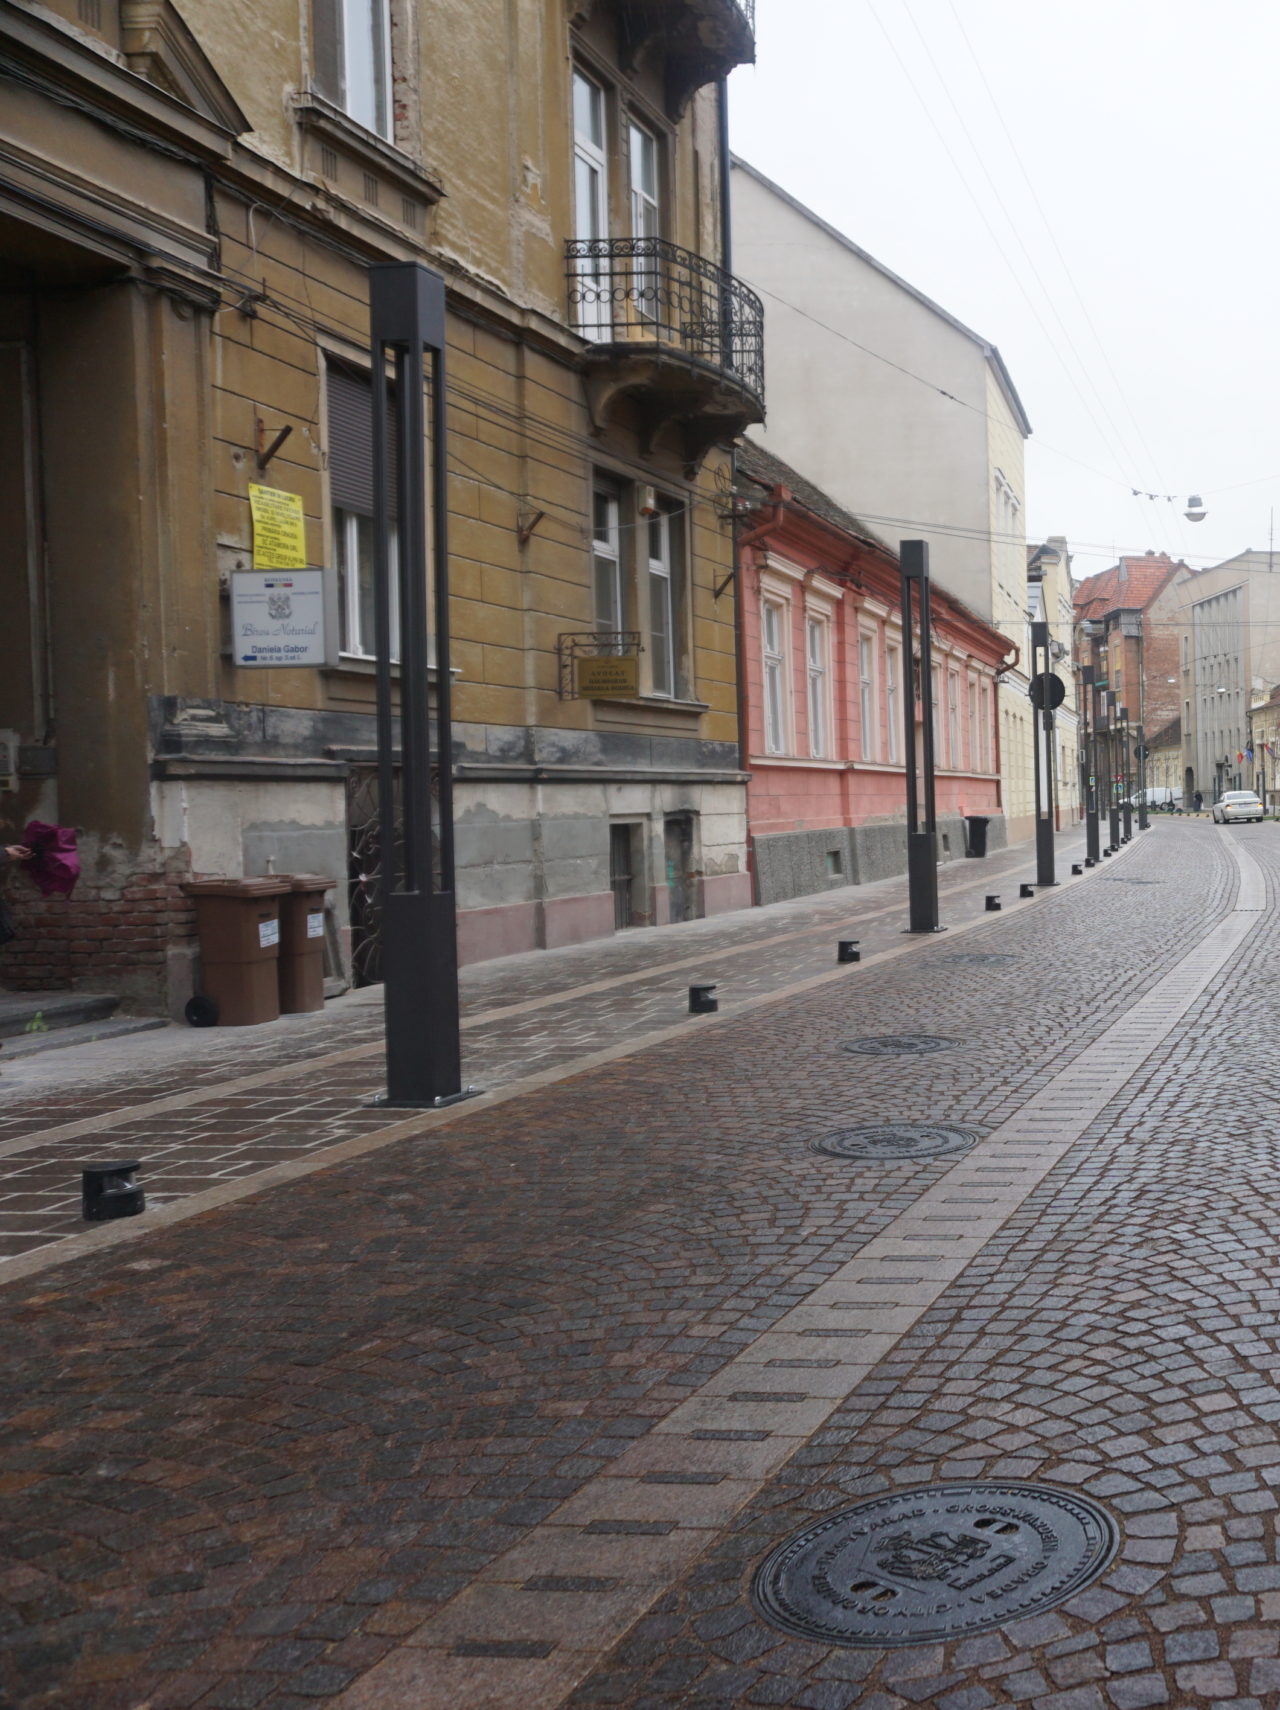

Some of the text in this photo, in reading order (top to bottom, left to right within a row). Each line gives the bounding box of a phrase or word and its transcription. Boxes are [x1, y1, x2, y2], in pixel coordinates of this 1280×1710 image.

[272, 622, 319, 636] Notarial
[251, 645, 308, 654] Daniela Gabor
